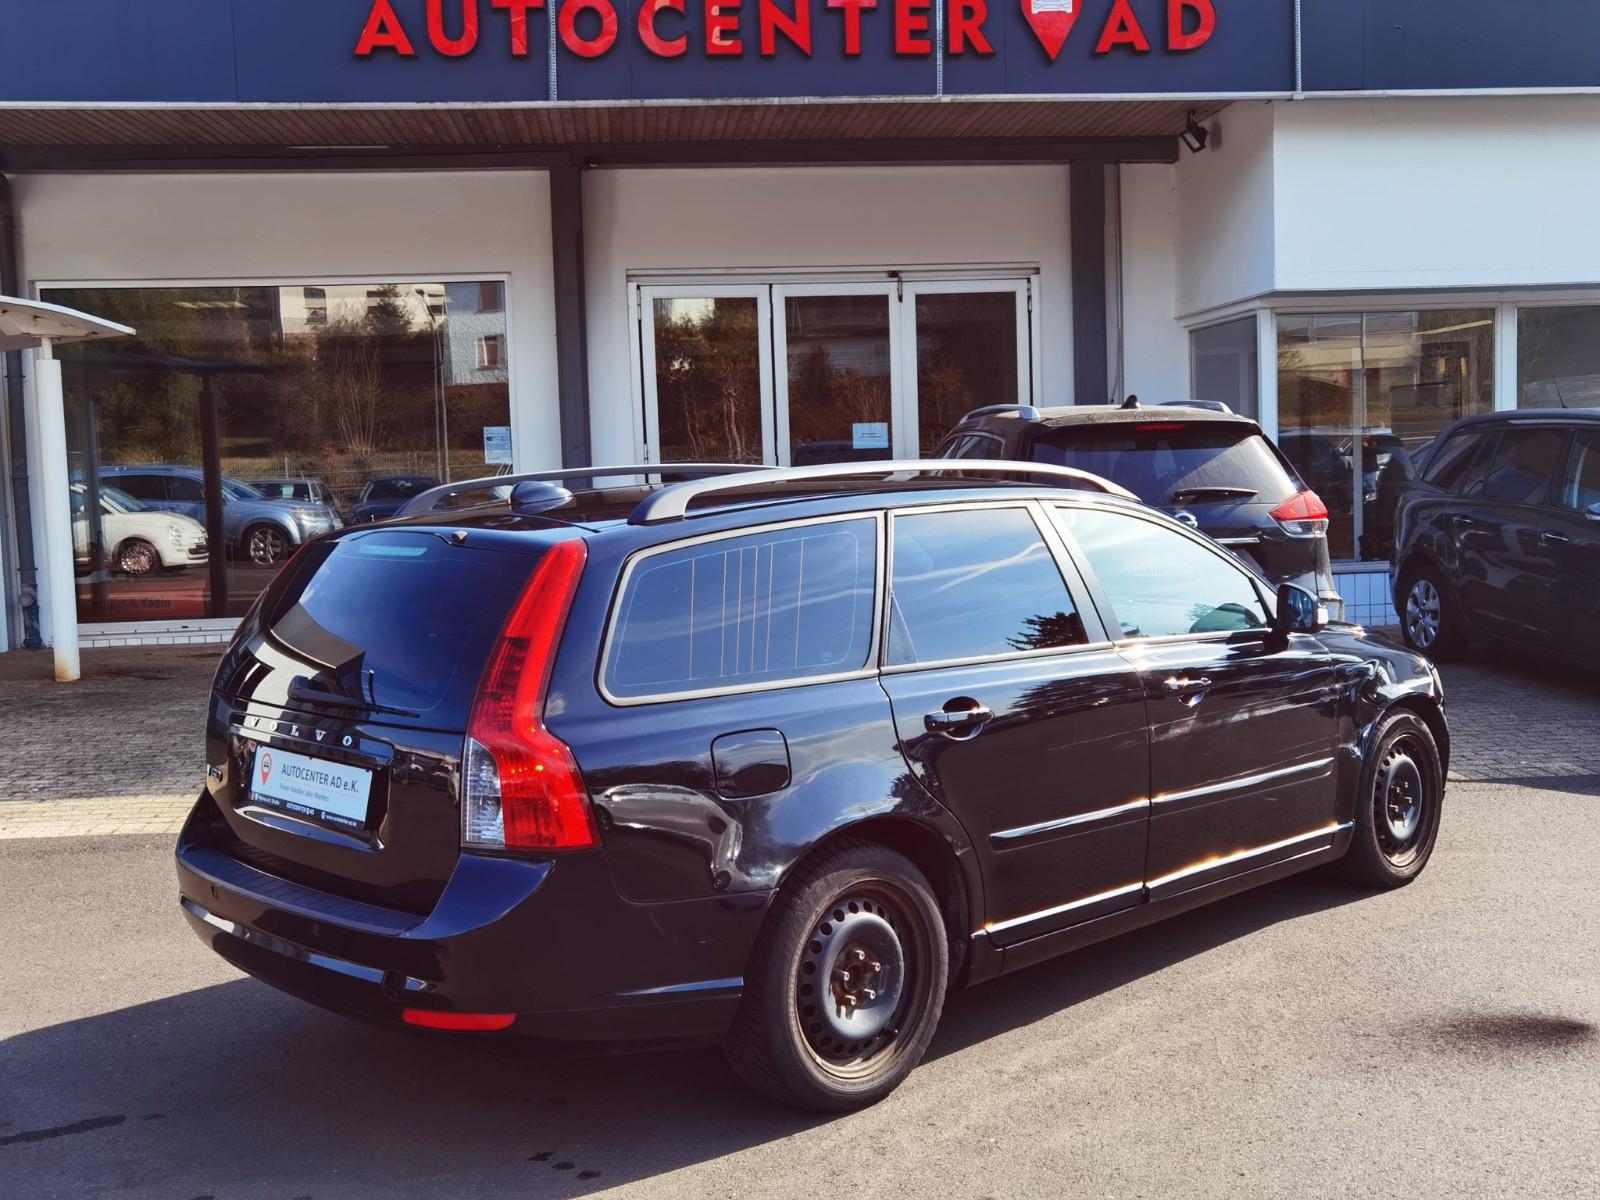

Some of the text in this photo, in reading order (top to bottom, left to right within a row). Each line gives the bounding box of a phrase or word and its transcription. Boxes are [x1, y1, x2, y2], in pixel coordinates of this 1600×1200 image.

[354, 0, 1217, 57] AUTOCENTER AD
[250, 717, 353, 747] VOLVO
[281, 763, 359, 793] AUTOCENTER AD e.K.
